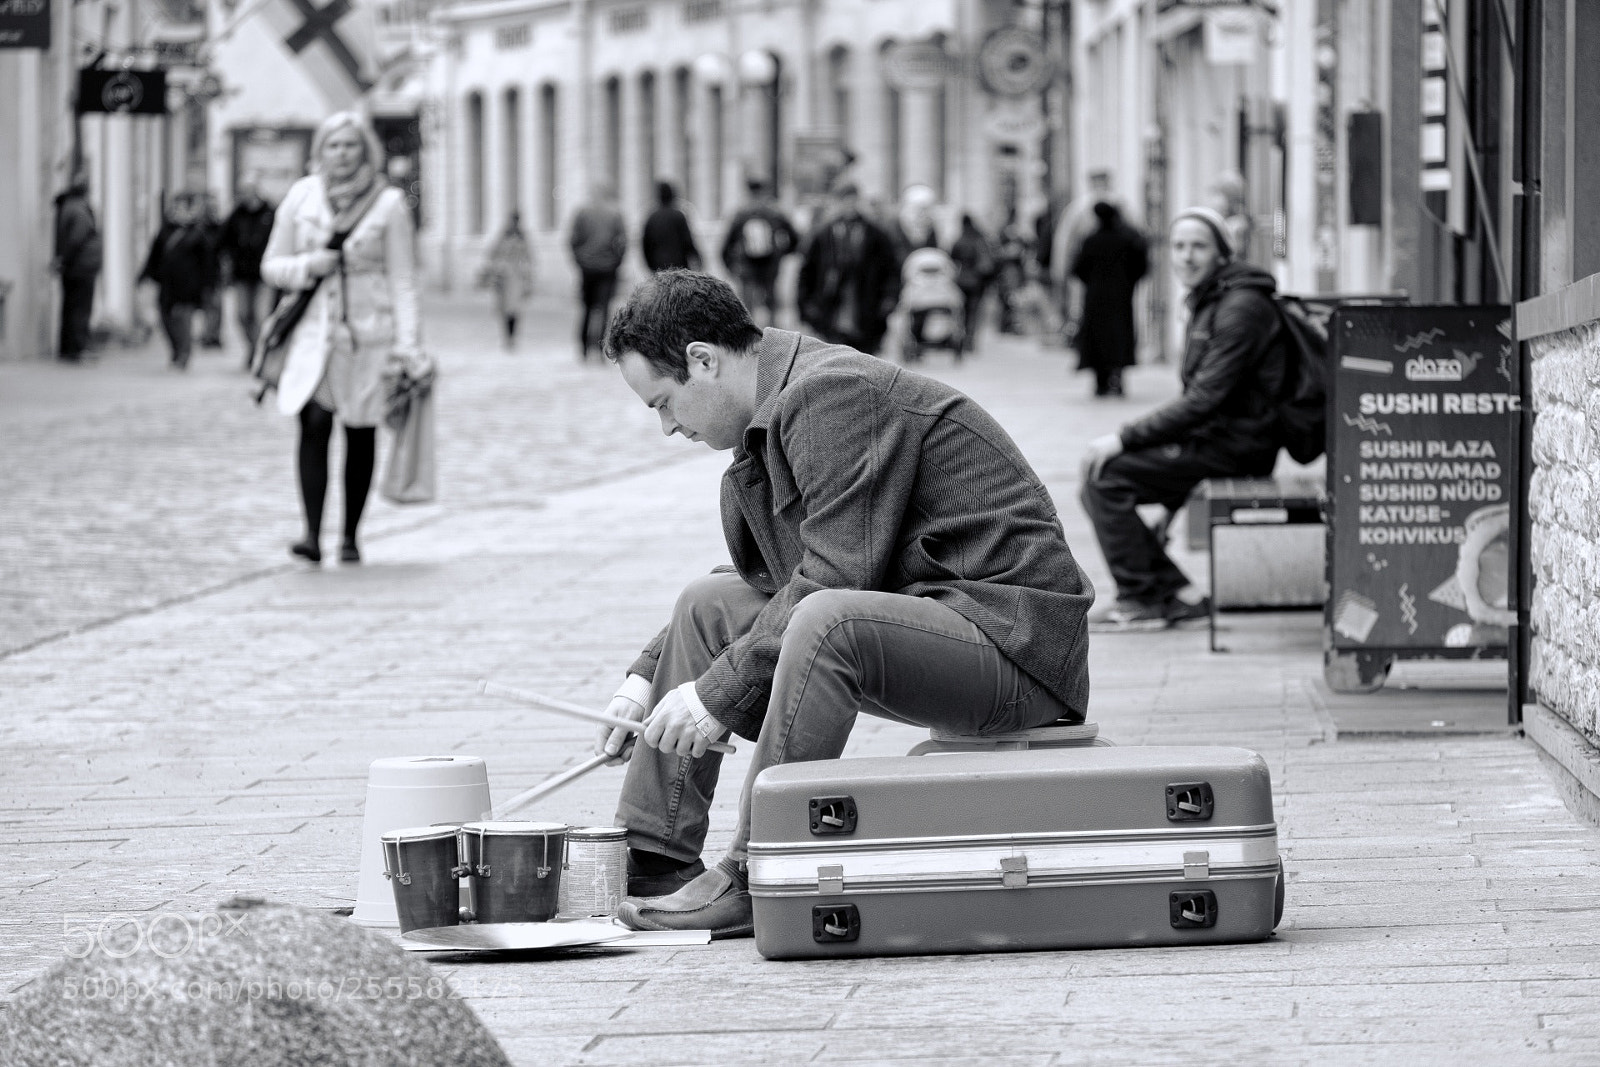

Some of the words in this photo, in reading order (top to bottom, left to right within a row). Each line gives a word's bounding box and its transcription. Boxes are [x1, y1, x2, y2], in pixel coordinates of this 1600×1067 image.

[1359, 393, 1438, 415] SUSHI
[1360, 440, 1423, 459] SUSHI
[1426, 440, 1496, 459] PLAZA
[1360, 461, 1501, 480] MAITSVAMAD
[1360, 483, 1438, 501] SUSHID
[1360, 504, 1451, 523] KATUSE-
[1360, 526, 1468, 545] KOHVIKUS
